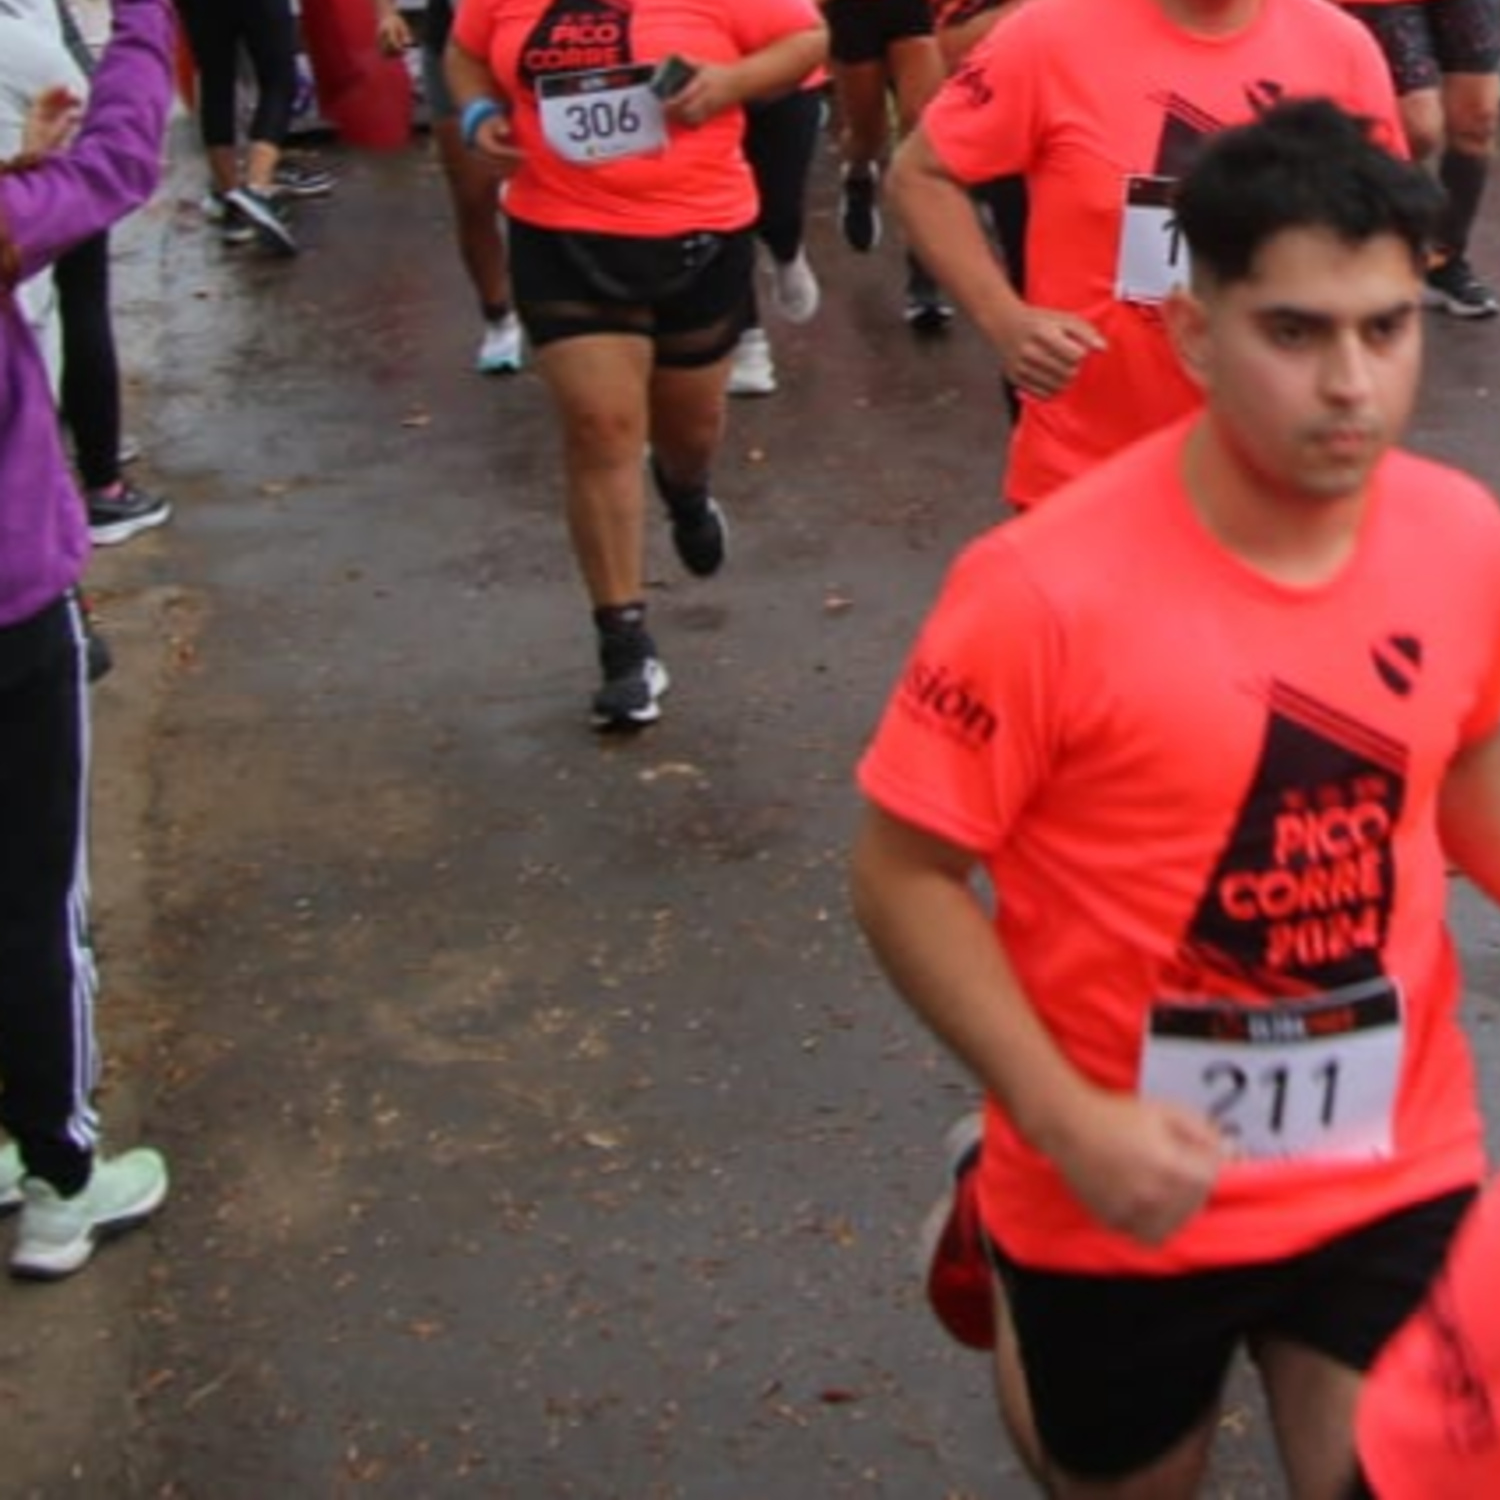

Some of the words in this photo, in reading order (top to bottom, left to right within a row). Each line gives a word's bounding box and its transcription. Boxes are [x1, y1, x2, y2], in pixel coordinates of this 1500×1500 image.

[564, 97, 641, 143] 306
[1275, 802, 1389, 866] PICO
[1219, 848, 1383, 922] CORRE
[1203, 1059, 1340, 1138] 211
